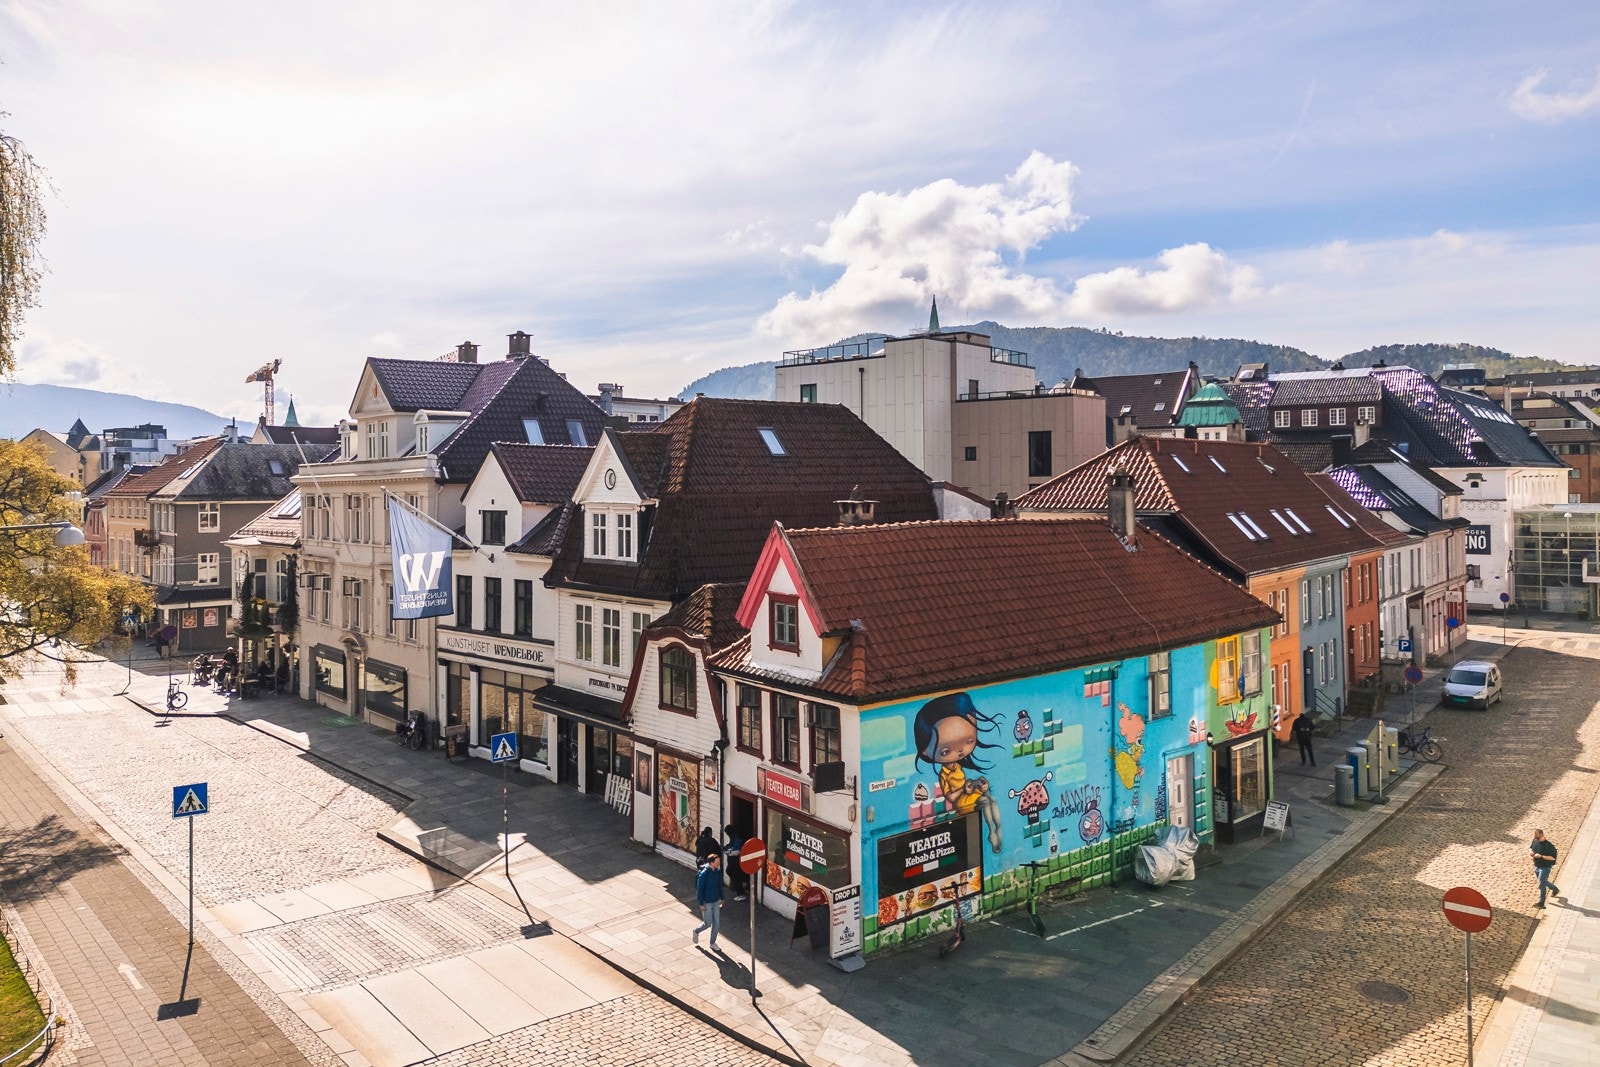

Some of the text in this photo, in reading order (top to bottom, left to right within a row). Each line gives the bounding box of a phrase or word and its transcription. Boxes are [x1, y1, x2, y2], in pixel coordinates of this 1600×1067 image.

[1465, 535, 1487, 550] !NO
[447, 637, 544, 663] KUNSTHUSET WENDELBOE
[1401, 641, 1409, 650] P
[767, 778, 799, 801] TEATER KEBAB
[789, 827, 824, 853] TEATER
[908, 831, 951, 854] TEATER
[786, 840, 827, 866] Kebab & Pizza
[905, 854, 929, 868] Kebab
[936, 846, 956, 858] Pizza
[835, 887, 857, 901] DROP IN
